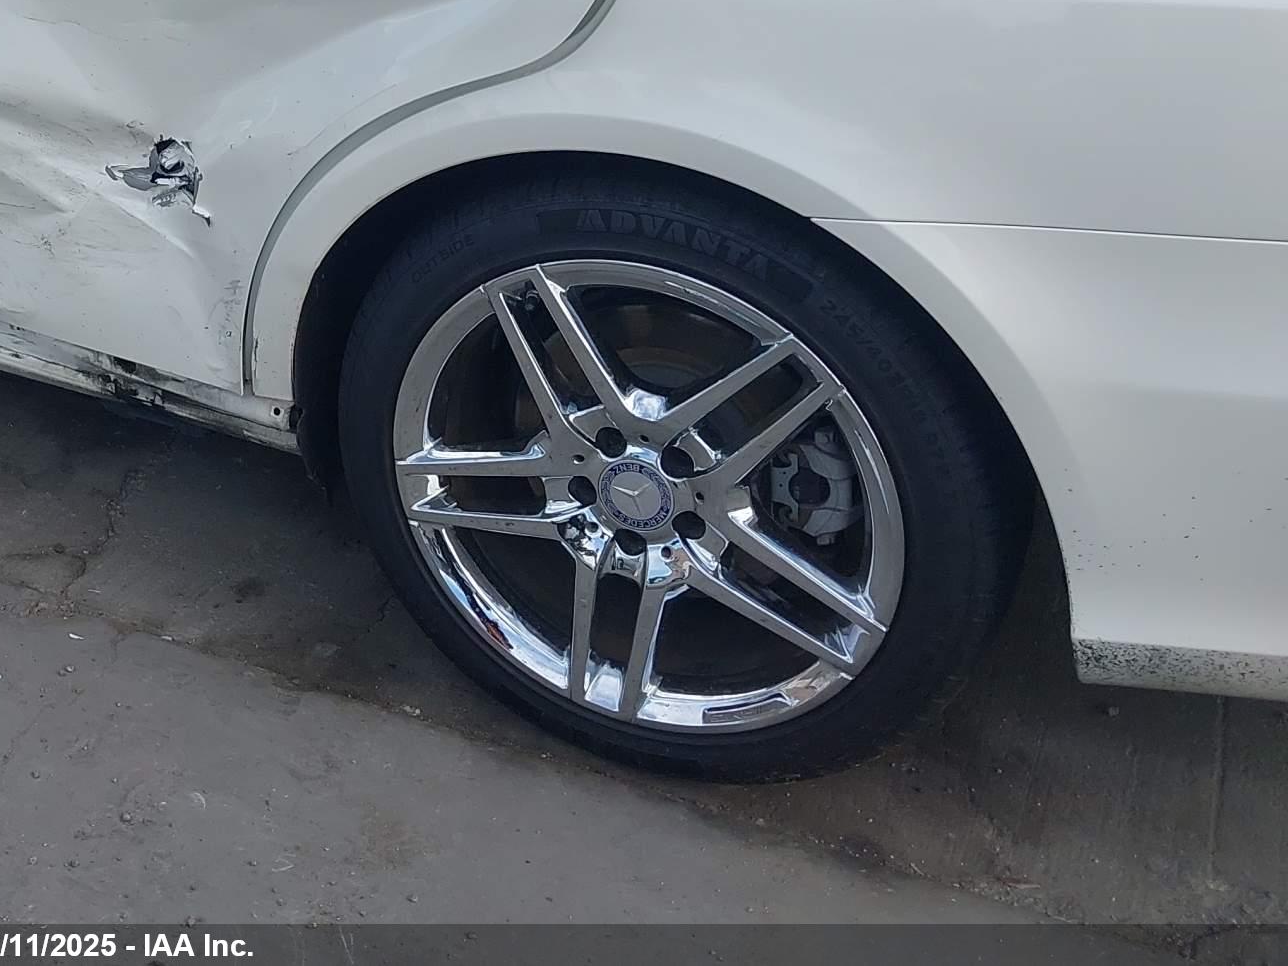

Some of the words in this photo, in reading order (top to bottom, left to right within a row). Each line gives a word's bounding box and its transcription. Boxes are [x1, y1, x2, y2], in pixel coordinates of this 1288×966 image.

[576, 209, 769, 281] ADVANTA
[613, 464, 641, 474] BENZ
[618, 511, 667, 529] MERCEDES
